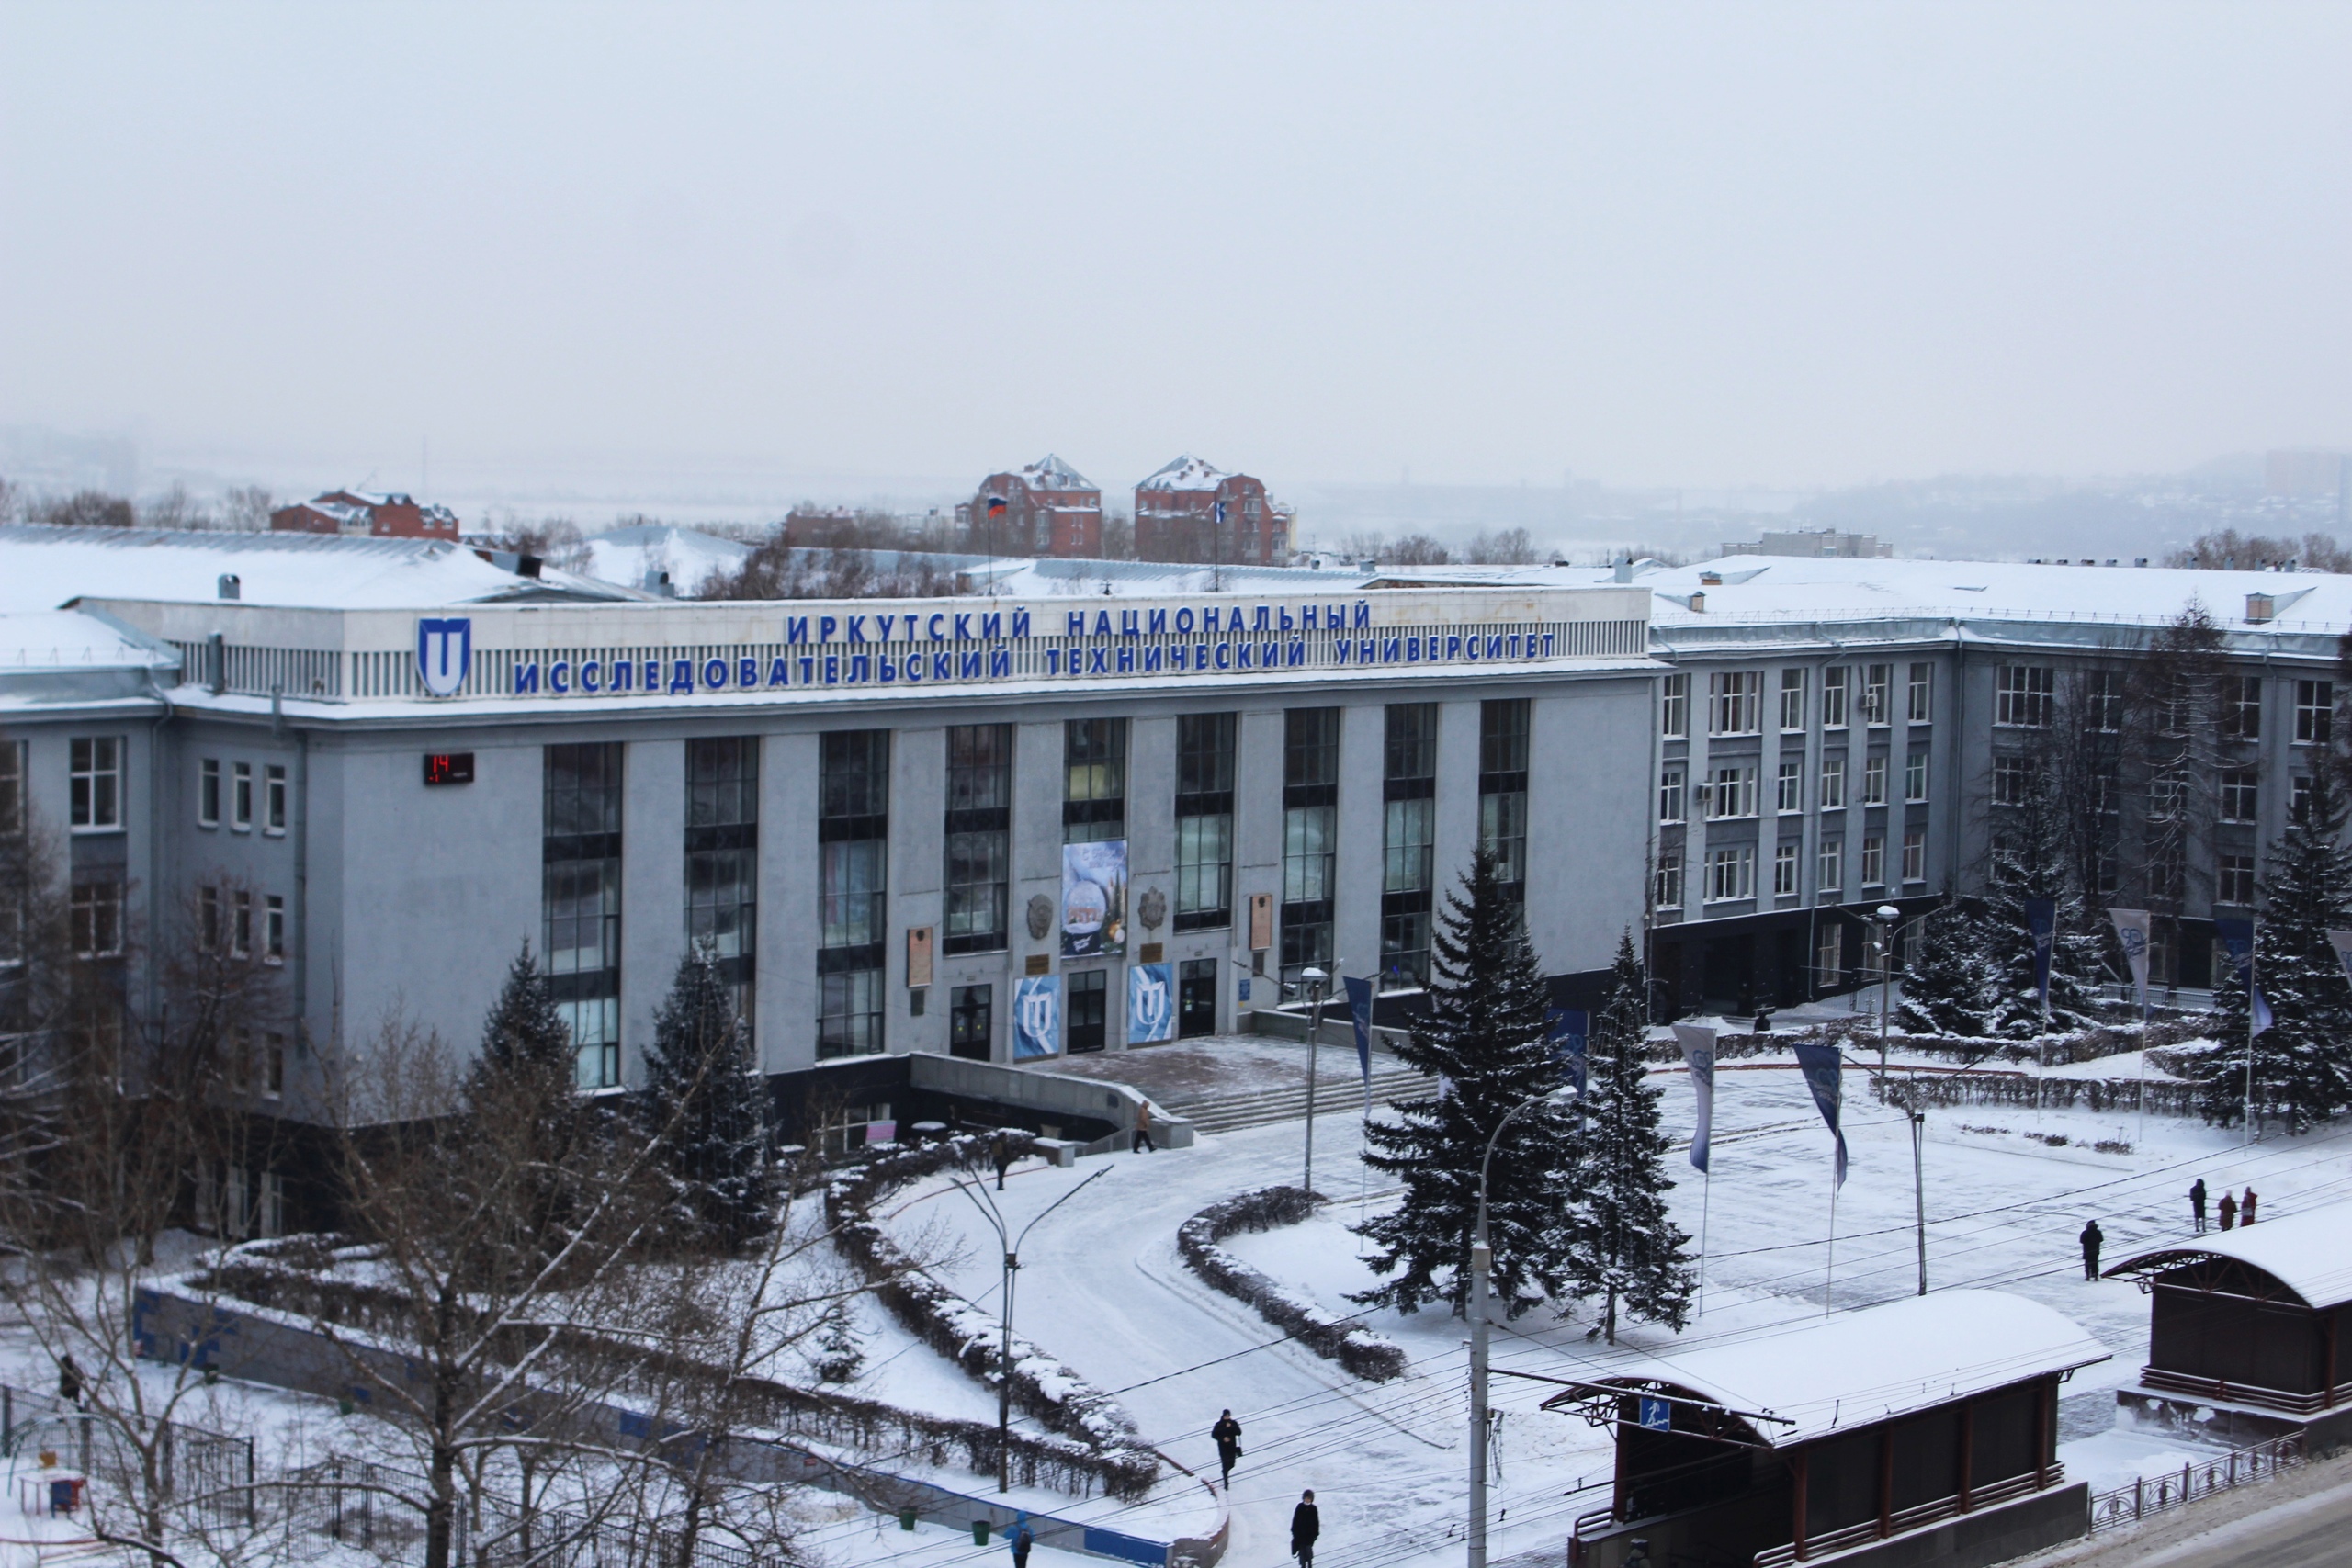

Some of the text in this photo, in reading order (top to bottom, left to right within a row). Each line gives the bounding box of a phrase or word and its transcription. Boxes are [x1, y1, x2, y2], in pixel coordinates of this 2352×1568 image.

[787, 599, 1370, 646] ИРКУТСКИЙ НАЦИОНАЛЬНЫЙ
[514, 633, 1555, 695] ИССЛЕДОВАТЕЛЬСКИЙ ТЕХНИЧЕСКИЙ УНИВЕРСИТЕТ
